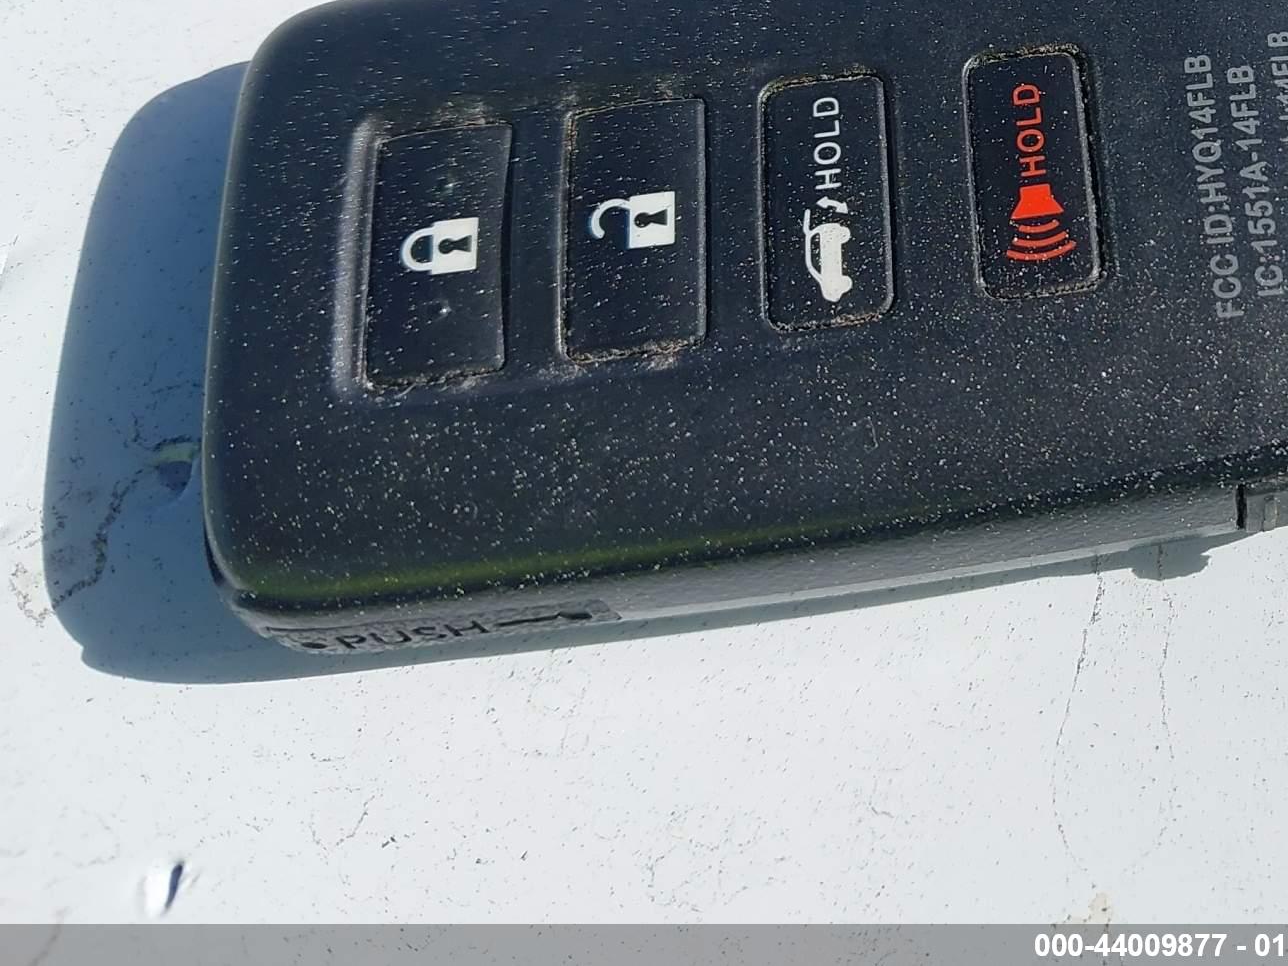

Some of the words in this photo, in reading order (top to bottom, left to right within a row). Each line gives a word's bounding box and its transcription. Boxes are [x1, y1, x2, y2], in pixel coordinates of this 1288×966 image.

[812, 97, 841, 190] HOLD
[1011, 83, 1047, 177] HOLD
[1184, 54, 1235, 244] ID:HYQ14FLB
[1227, 65, 1283, 296] IC:1551A-14FLB
[1210, 253, 1244, 319] FCC
[335, 620, 490, 650] PUSH
